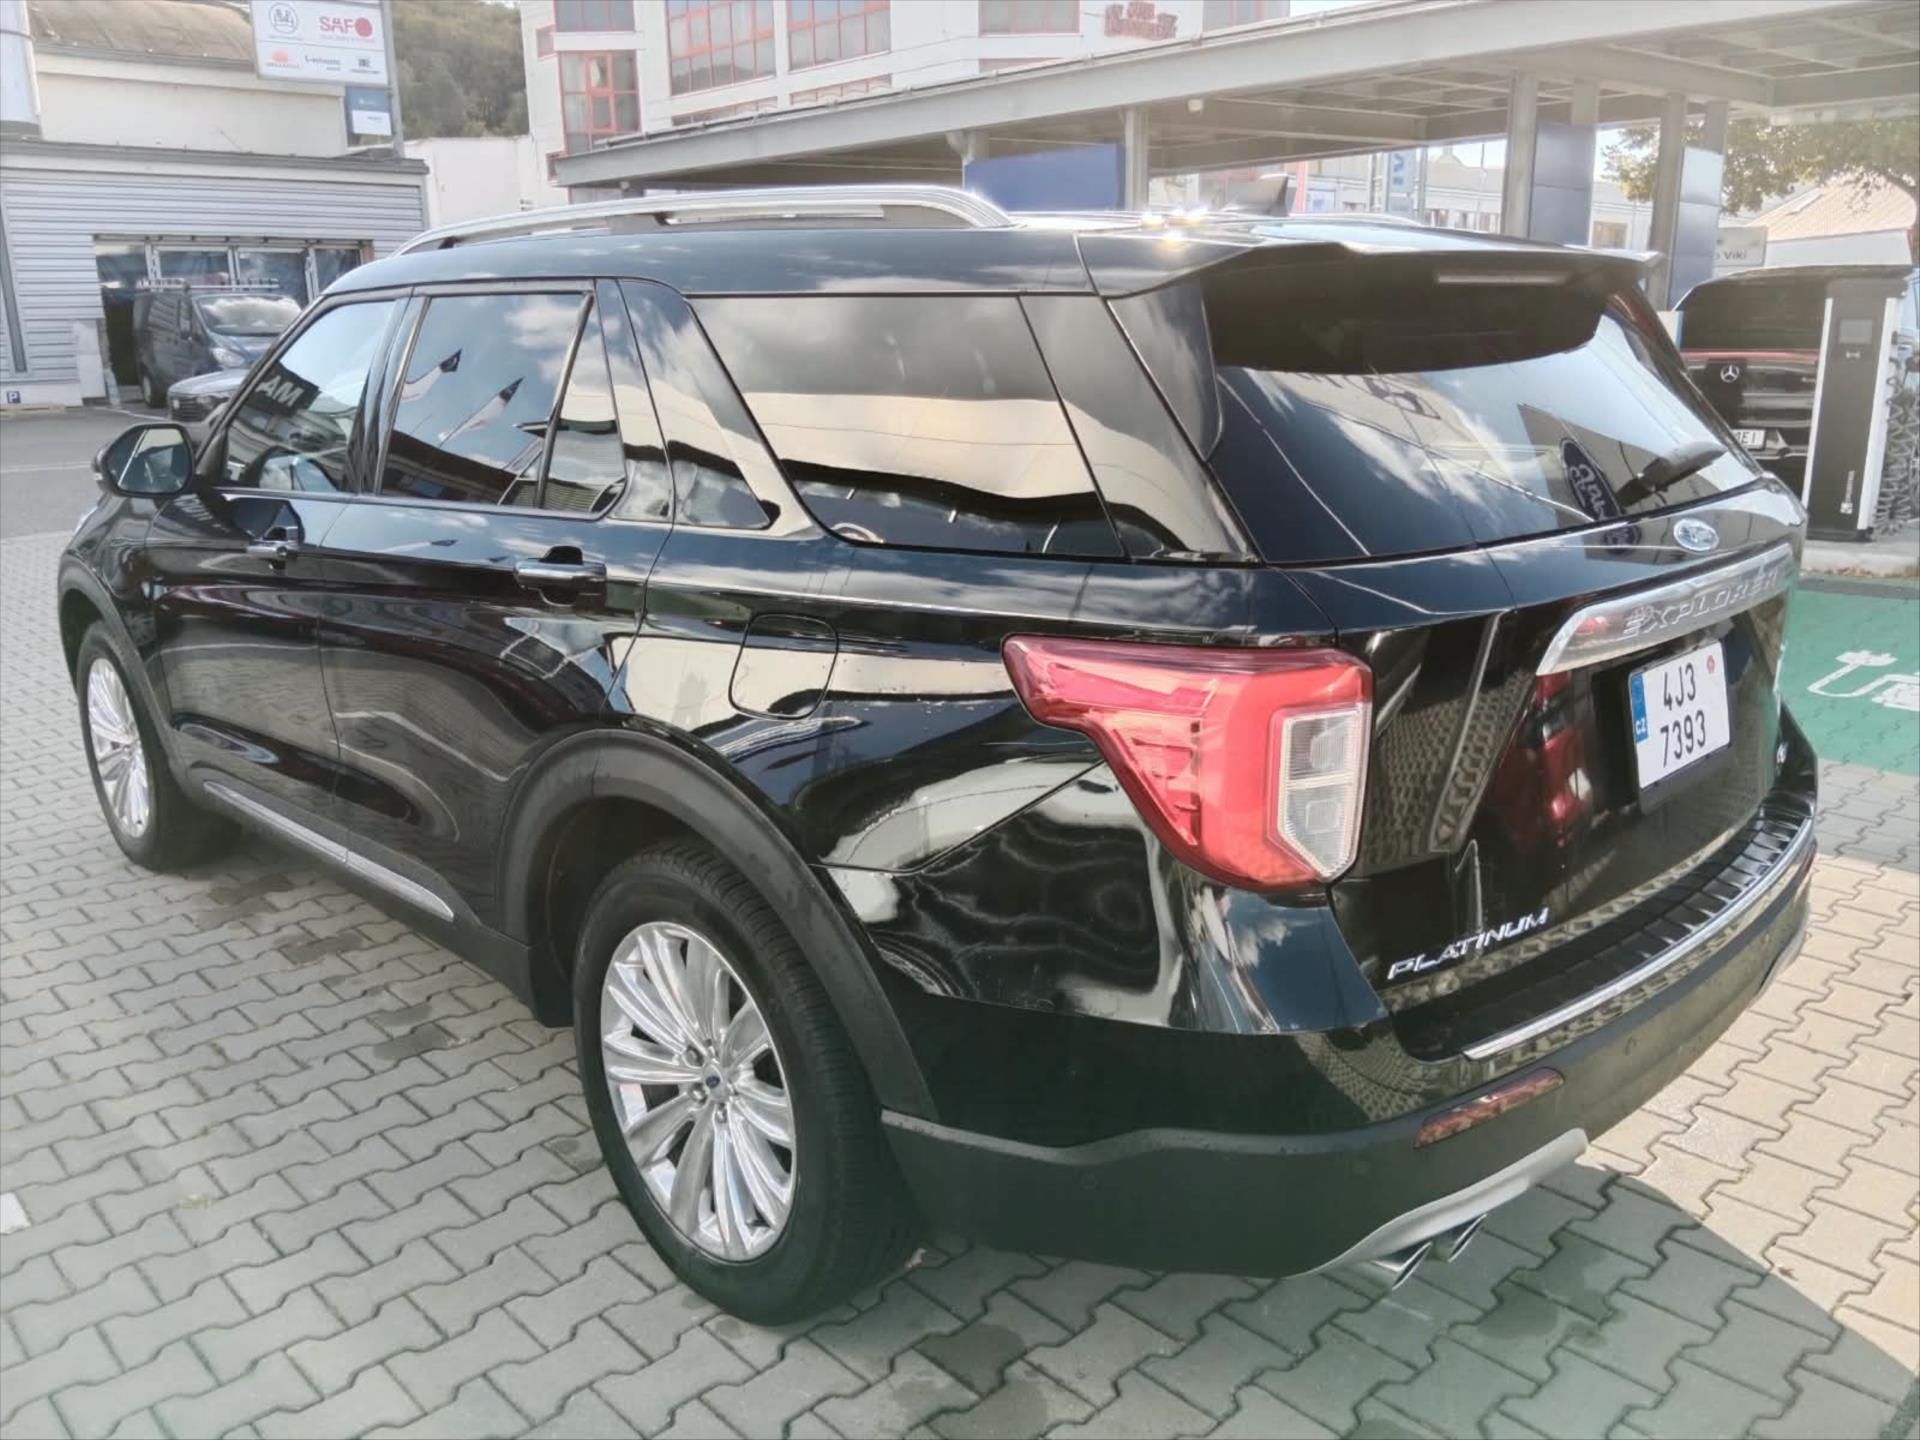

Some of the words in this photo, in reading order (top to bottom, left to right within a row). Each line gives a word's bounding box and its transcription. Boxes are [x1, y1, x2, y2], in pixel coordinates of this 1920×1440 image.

[1623, 569, 1778, 639] EXPLORER
[1663, 662, 1696, 711] 4J3
[1635, 718, 1647, 735] CZ
[1660, 709, 1706, 768] 7393
[1387, 907, 1549, 980] PLATINUM
